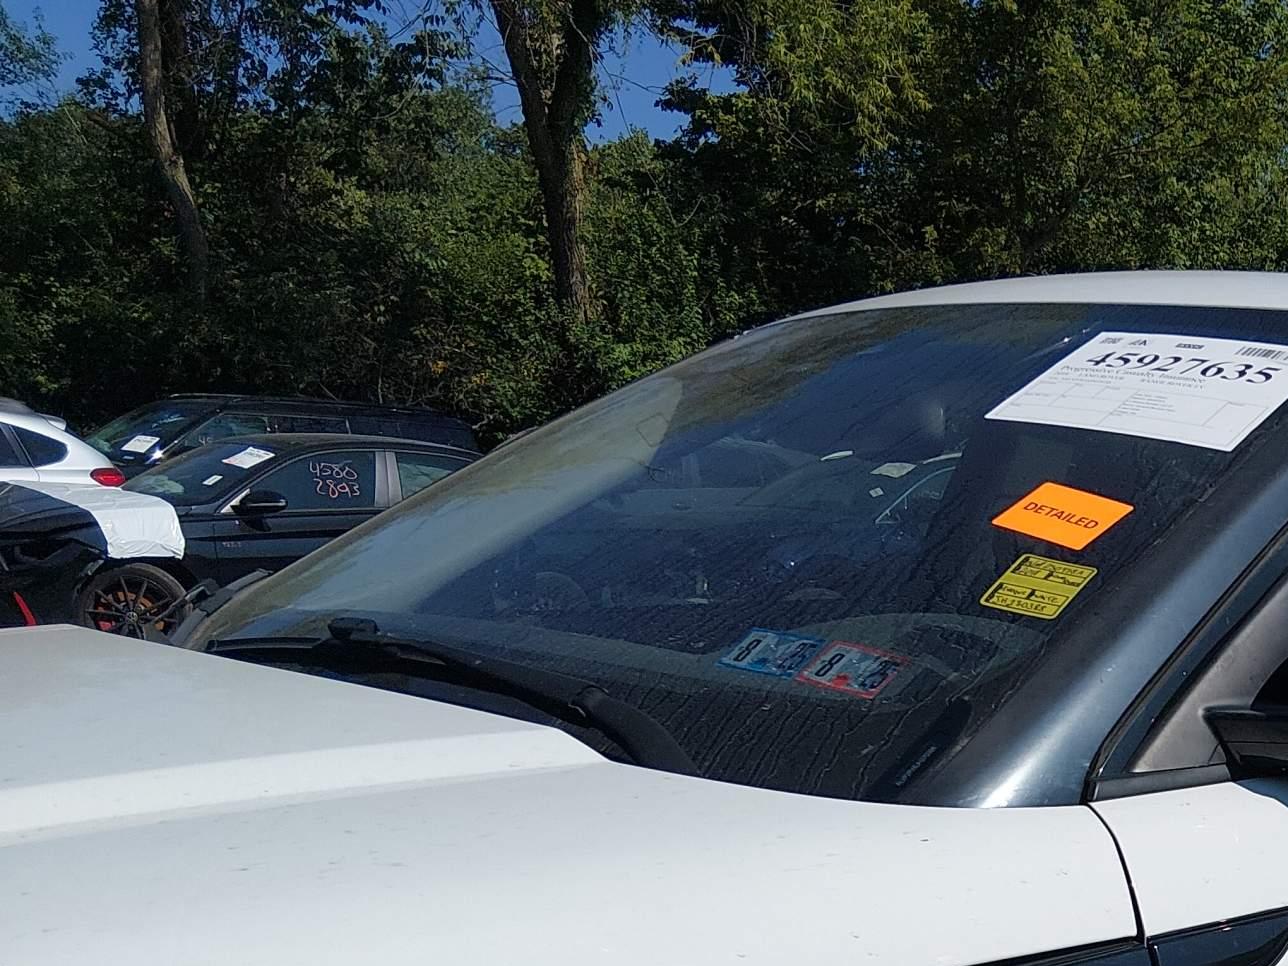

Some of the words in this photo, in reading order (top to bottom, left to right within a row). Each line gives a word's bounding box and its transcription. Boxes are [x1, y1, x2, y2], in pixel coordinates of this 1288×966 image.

[1086, 351, 1283, 385] 45927635
[313, 478, 361, 498] 2893
[1023, 501, 1099, 529] DETAILED
